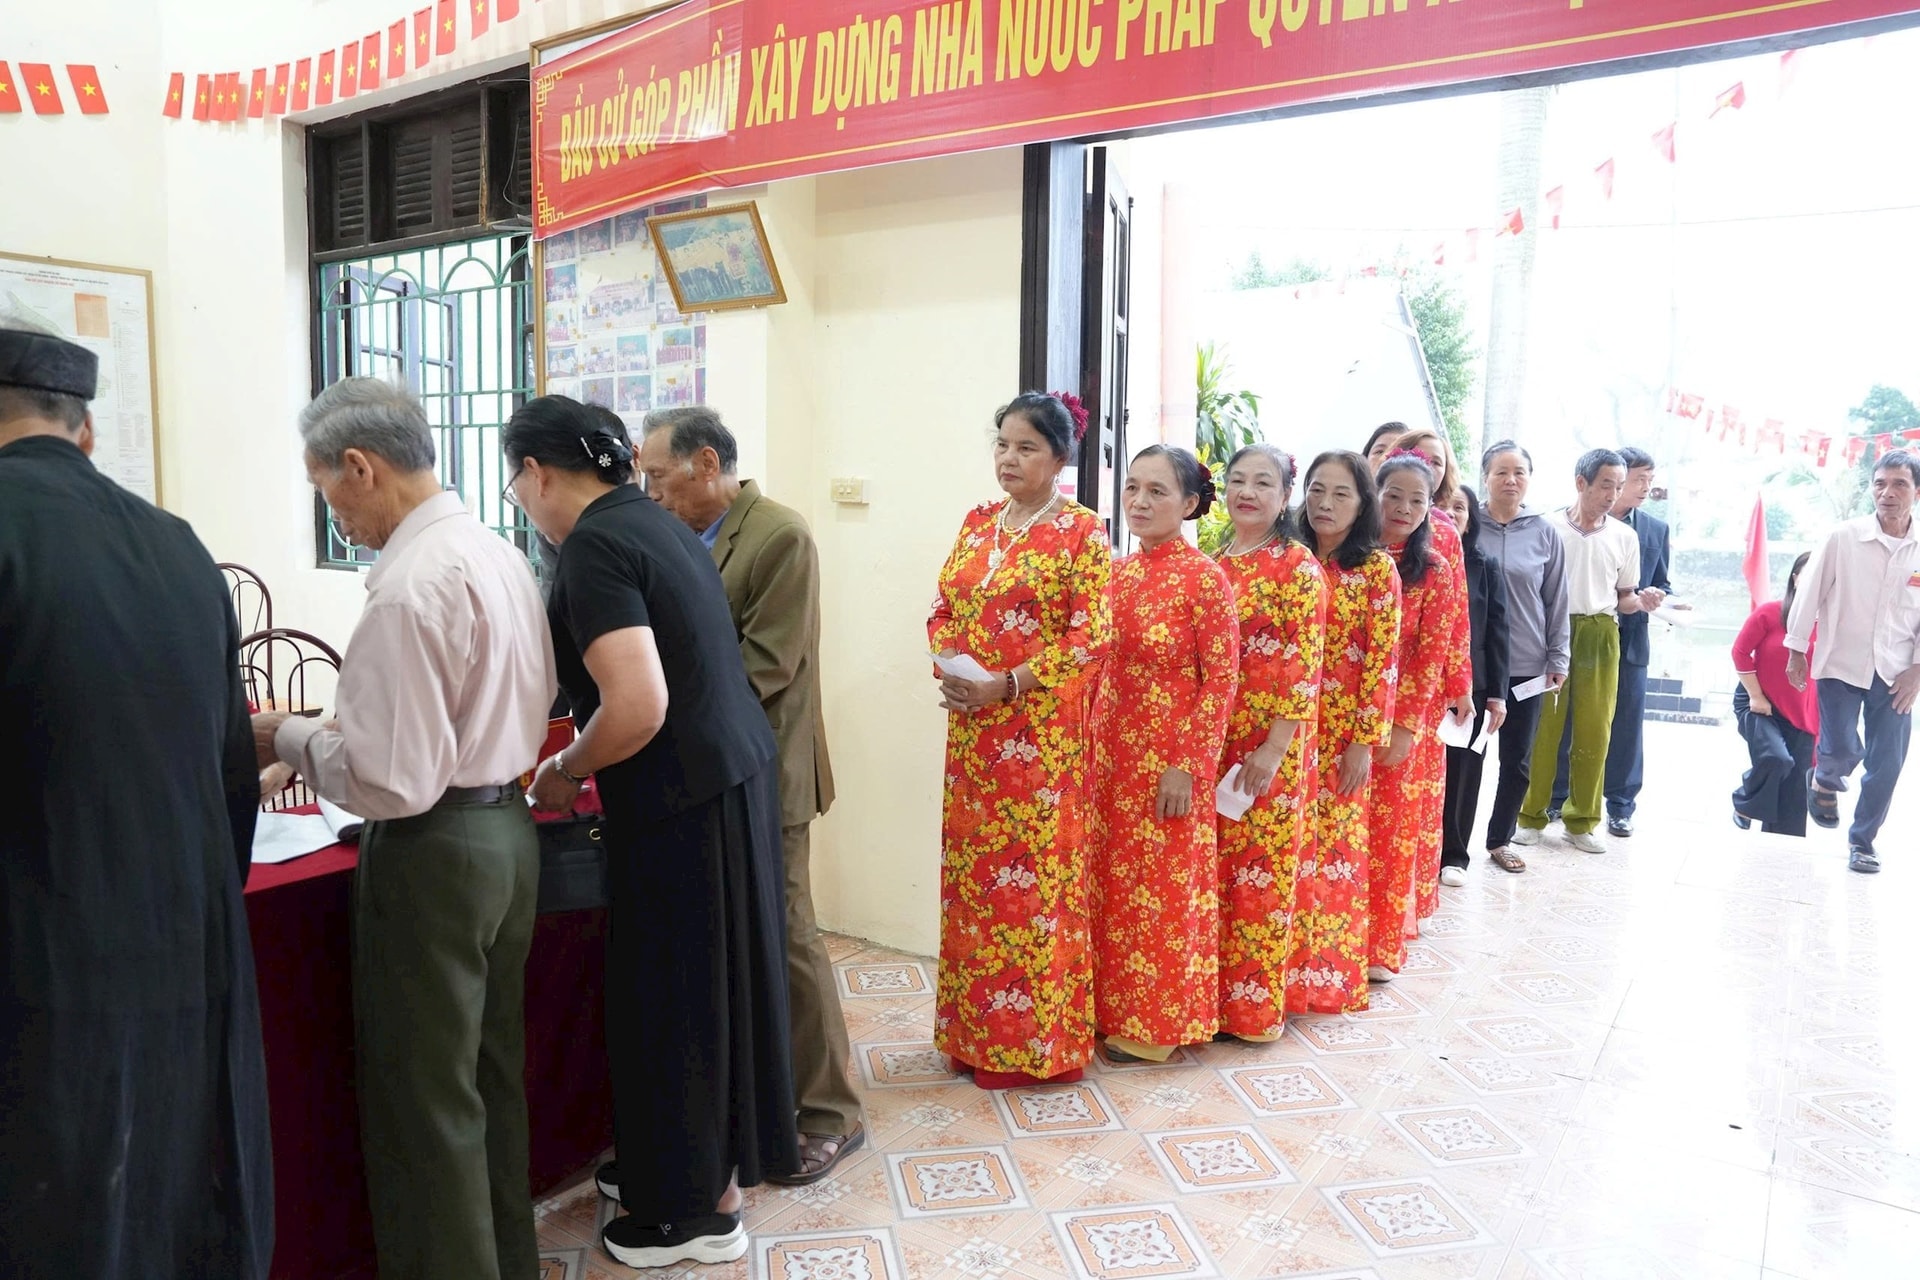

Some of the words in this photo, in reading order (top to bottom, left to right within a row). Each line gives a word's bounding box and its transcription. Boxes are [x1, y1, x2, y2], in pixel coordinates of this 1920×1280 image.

[625, 64, 671, 160] GÓP
[745, 23, 807, 128] XÂY
[812, 14, 903, 131] DỰNG
